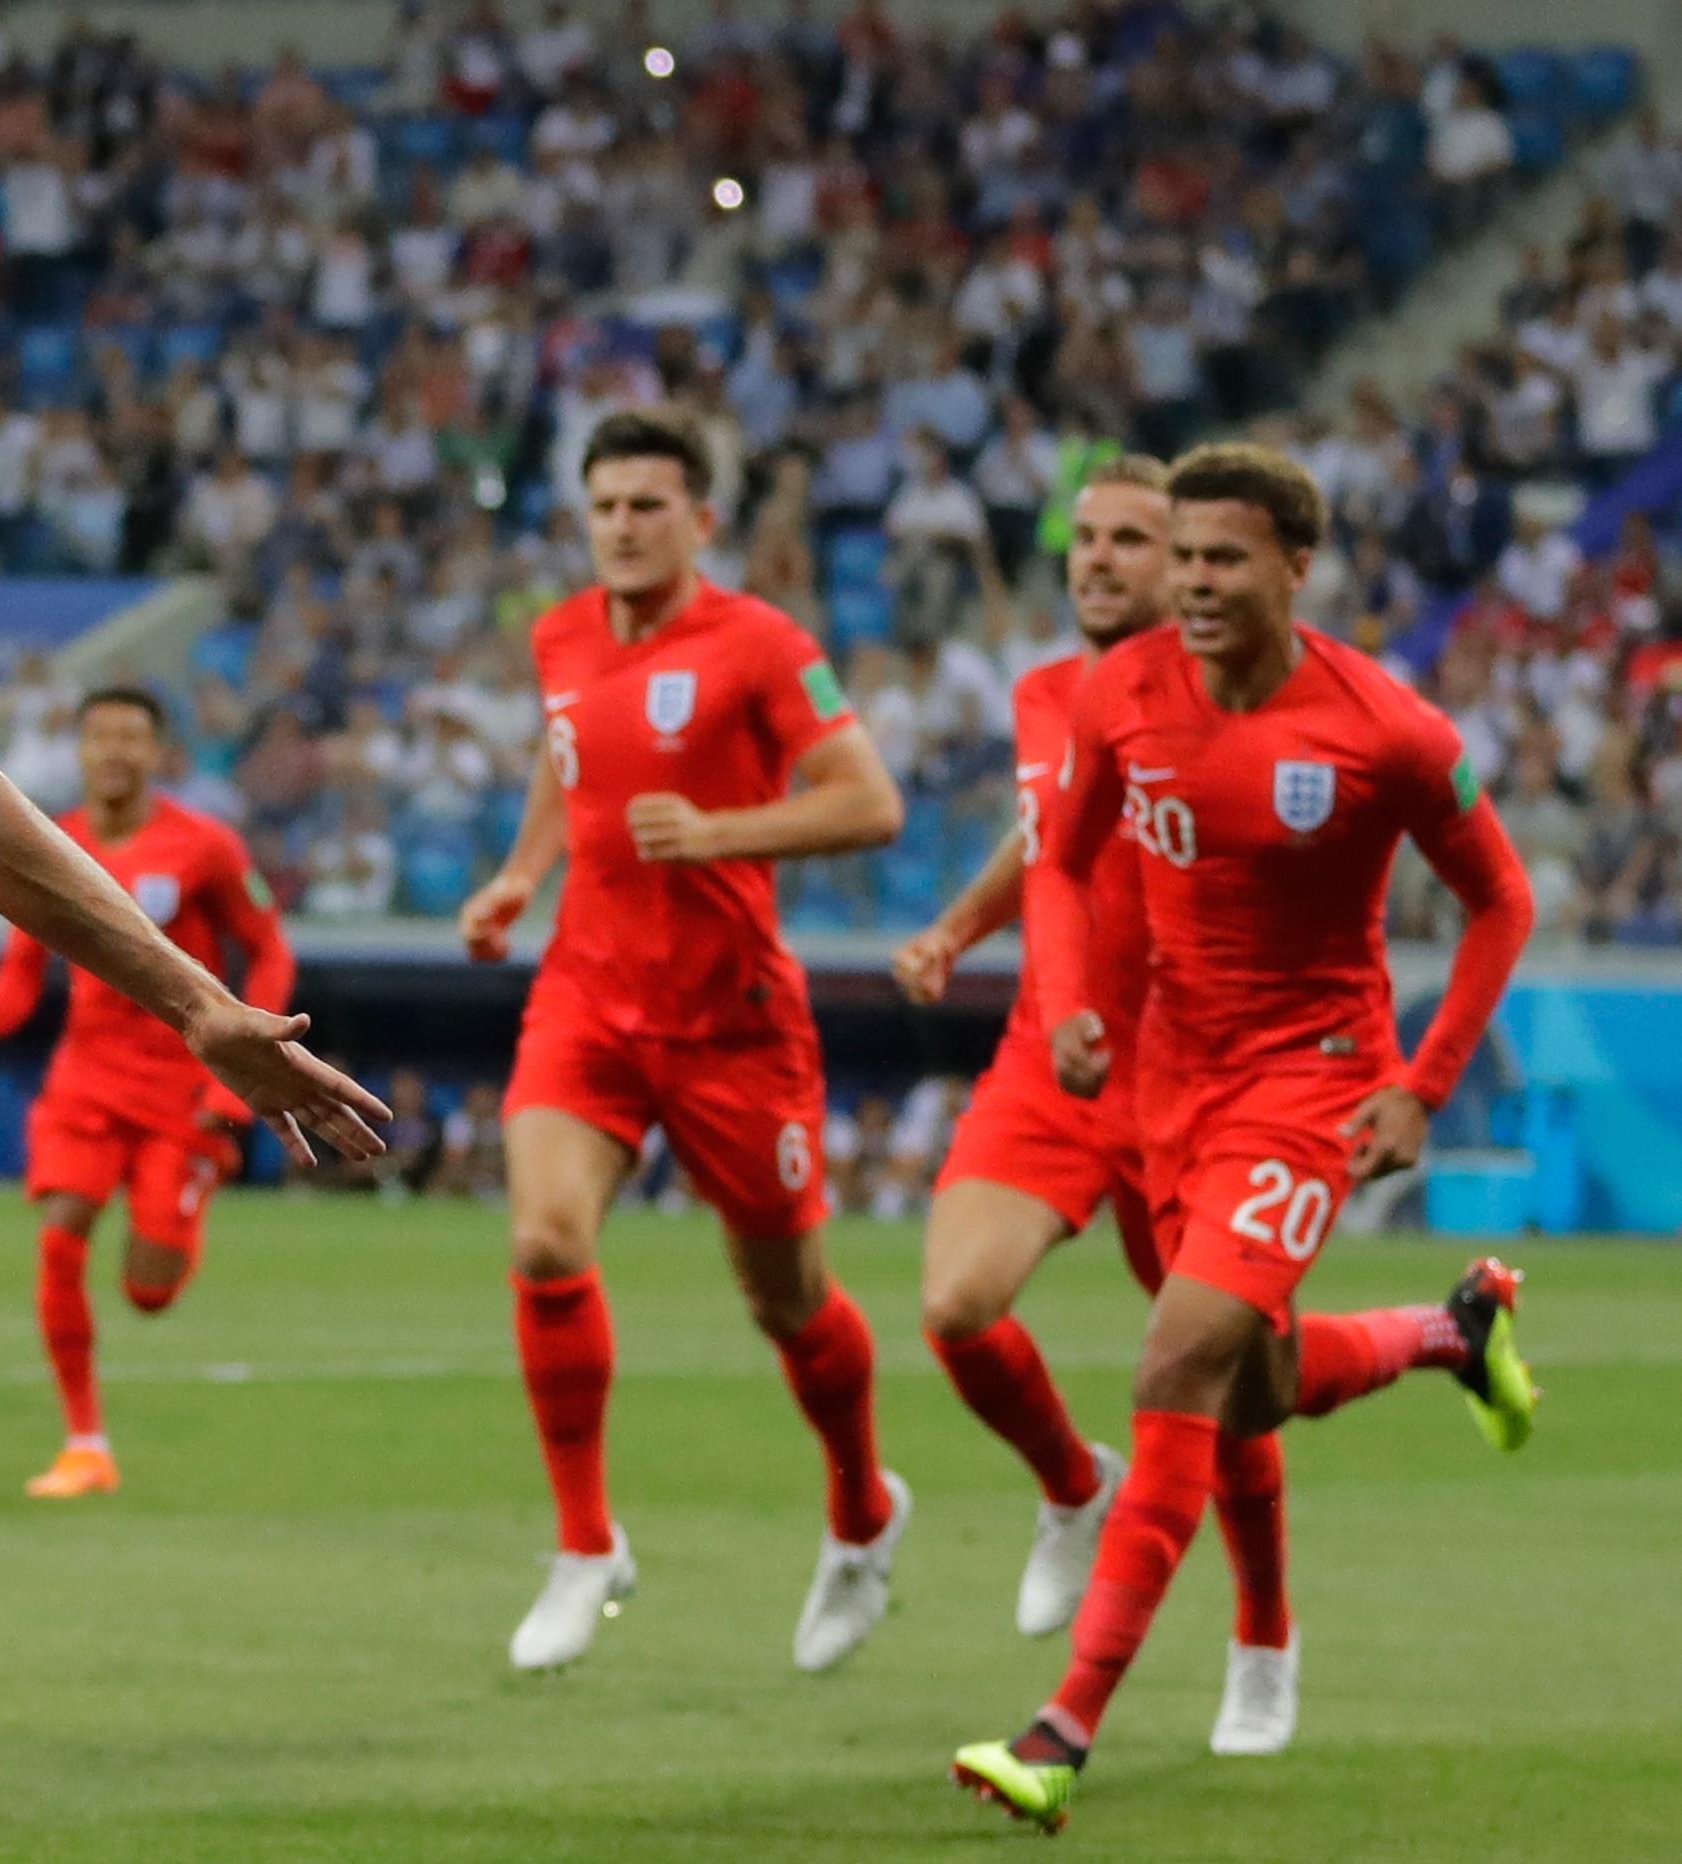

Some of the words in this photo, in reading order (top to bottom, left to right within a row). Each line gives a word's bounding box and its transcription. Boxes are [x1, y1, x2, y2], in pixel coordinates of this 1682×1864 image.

[1119, 783, 1198, 869] 20
[775, 1120, 812, 1191] 6
[1229, 1158, 1333, 1262] 20
